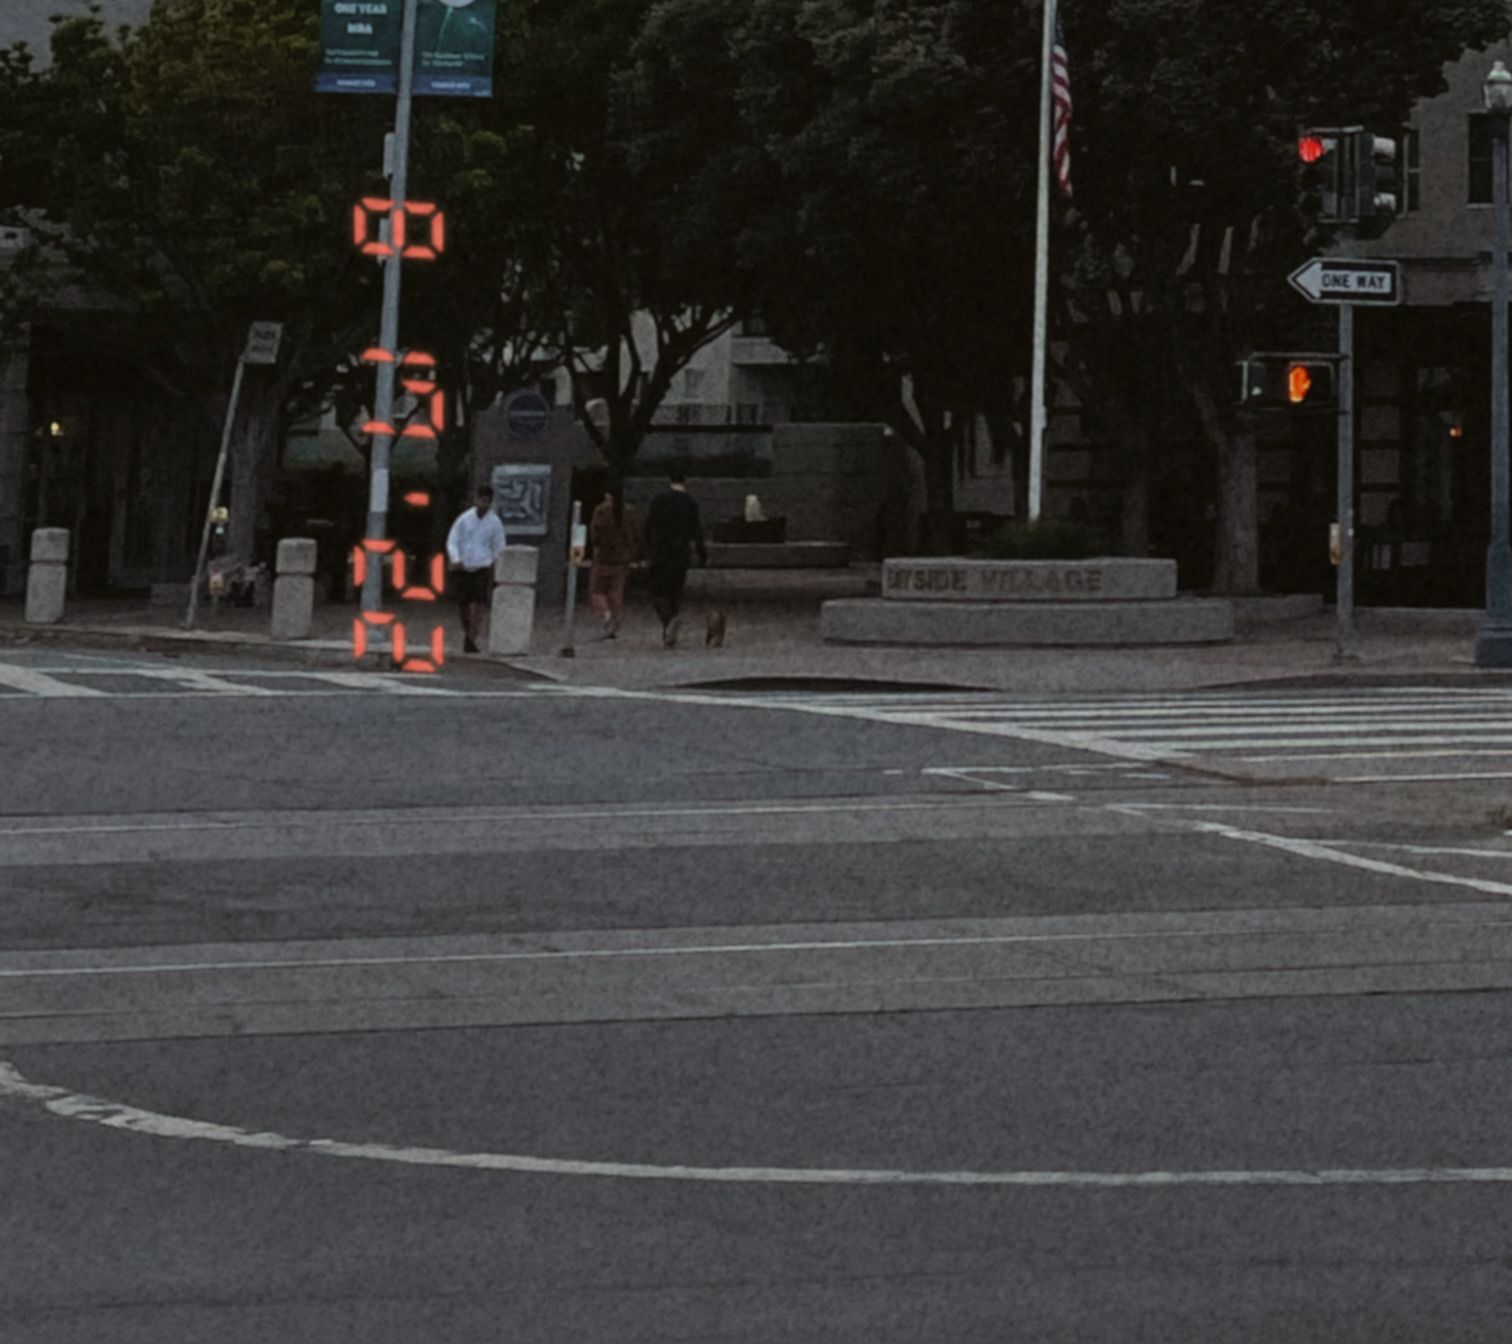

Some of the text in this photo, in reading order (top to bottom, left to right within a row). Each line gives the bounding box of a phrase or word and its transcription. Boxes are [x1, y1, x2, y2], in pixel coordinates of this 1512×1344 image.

[1321, 273, 1386, 289] ONE WAY
[981, 568, 1103, 593] VILLAGE
